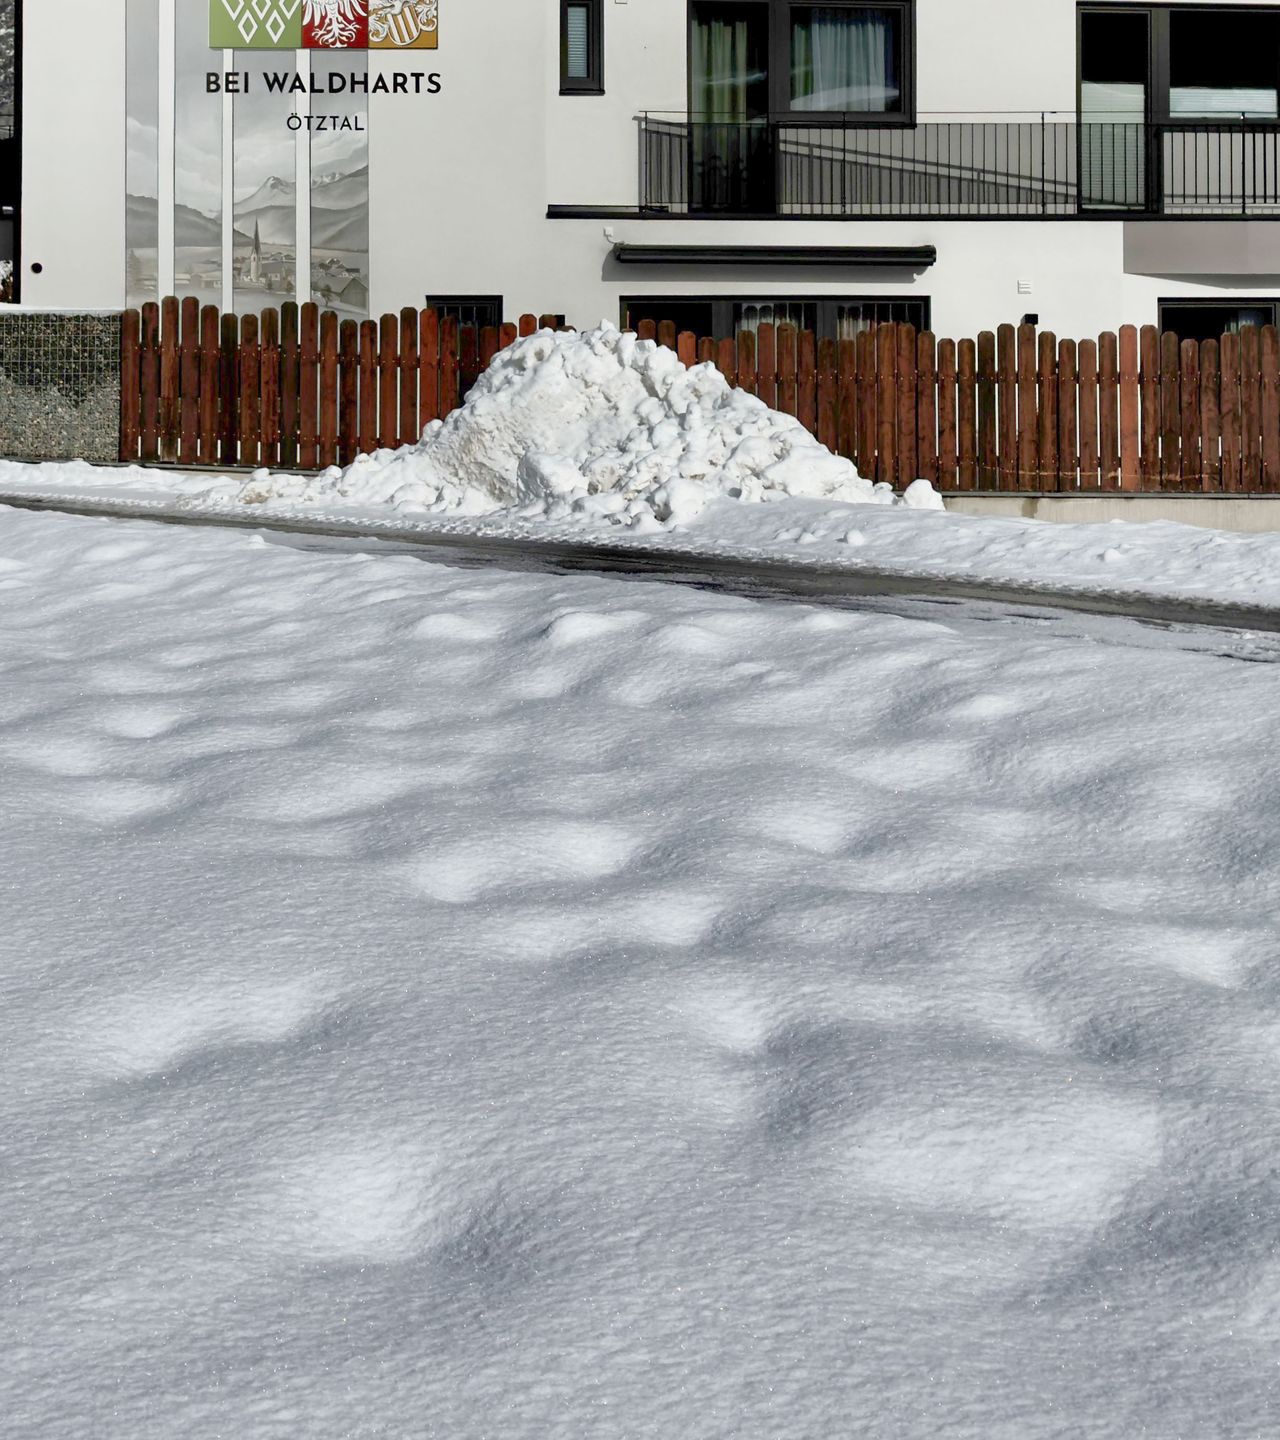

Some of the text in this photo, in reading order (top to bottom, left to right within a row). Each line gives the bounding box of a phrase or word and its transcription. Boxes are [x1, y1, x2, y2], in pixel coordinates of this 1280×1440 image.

[206, 72, 442, 94] BEI WALDHARTS
[286, 113, 365, 131] ÖTZTAL
